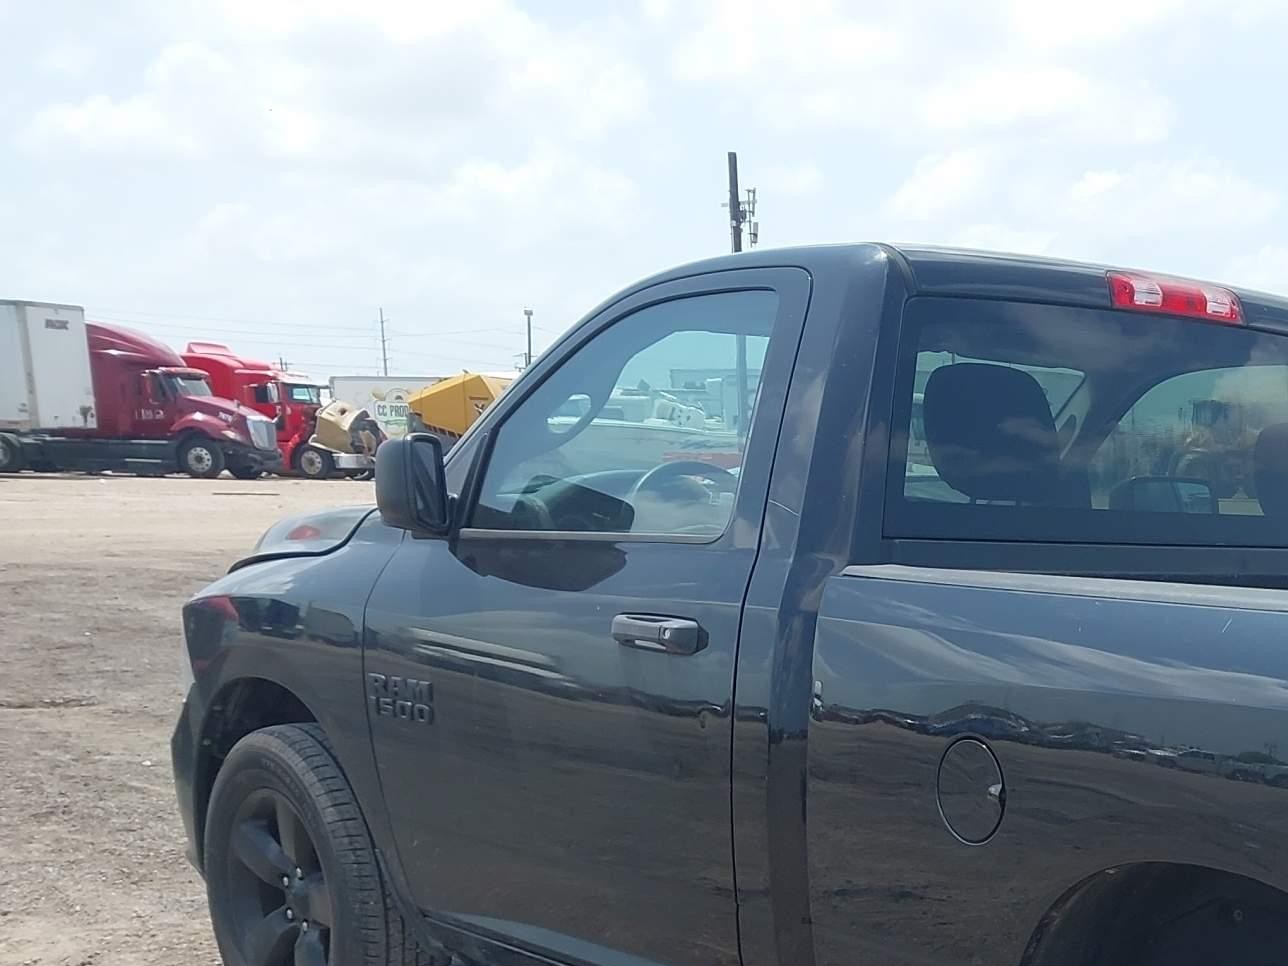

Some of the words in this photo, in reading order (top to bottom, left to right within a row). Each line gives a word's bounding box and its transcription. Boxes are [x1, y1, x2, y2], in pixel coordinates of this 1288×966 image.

[377, 404, 388, 417] CC
[368, 672, 434, 703] RAM
[369, 695, 434, 725] 1500
